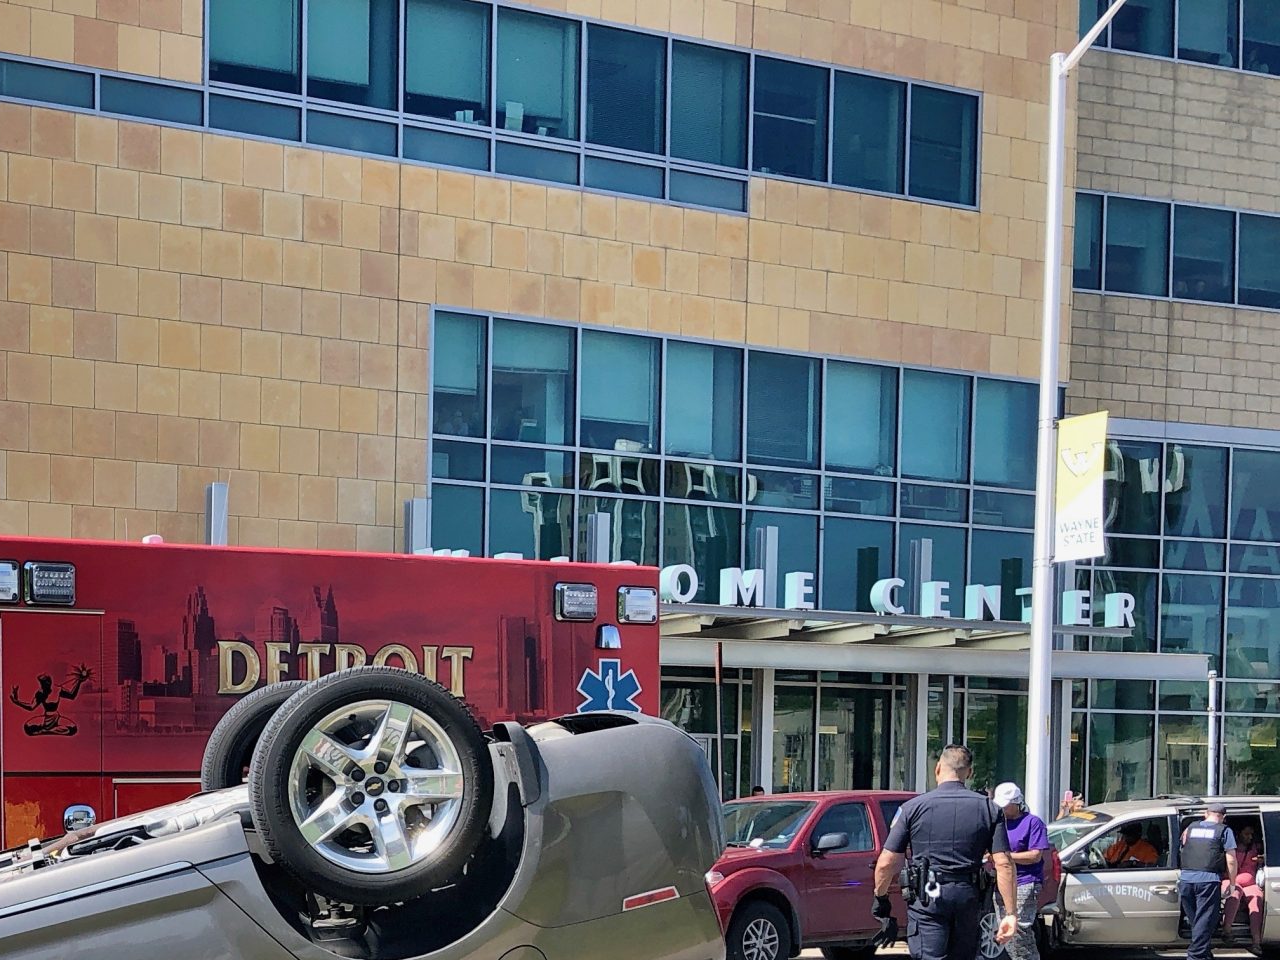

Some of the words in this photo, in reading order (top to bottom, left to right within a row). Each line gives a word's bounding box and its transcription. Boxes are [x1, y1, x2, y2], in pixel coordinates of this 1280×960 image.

[1059, 517, 1099, 533] WAYNE
[1063, 530, 1096, 547] STATE
[217, 640, 473, 698] DETROIT
[1115, 884, 1154, 903] DETROIT
